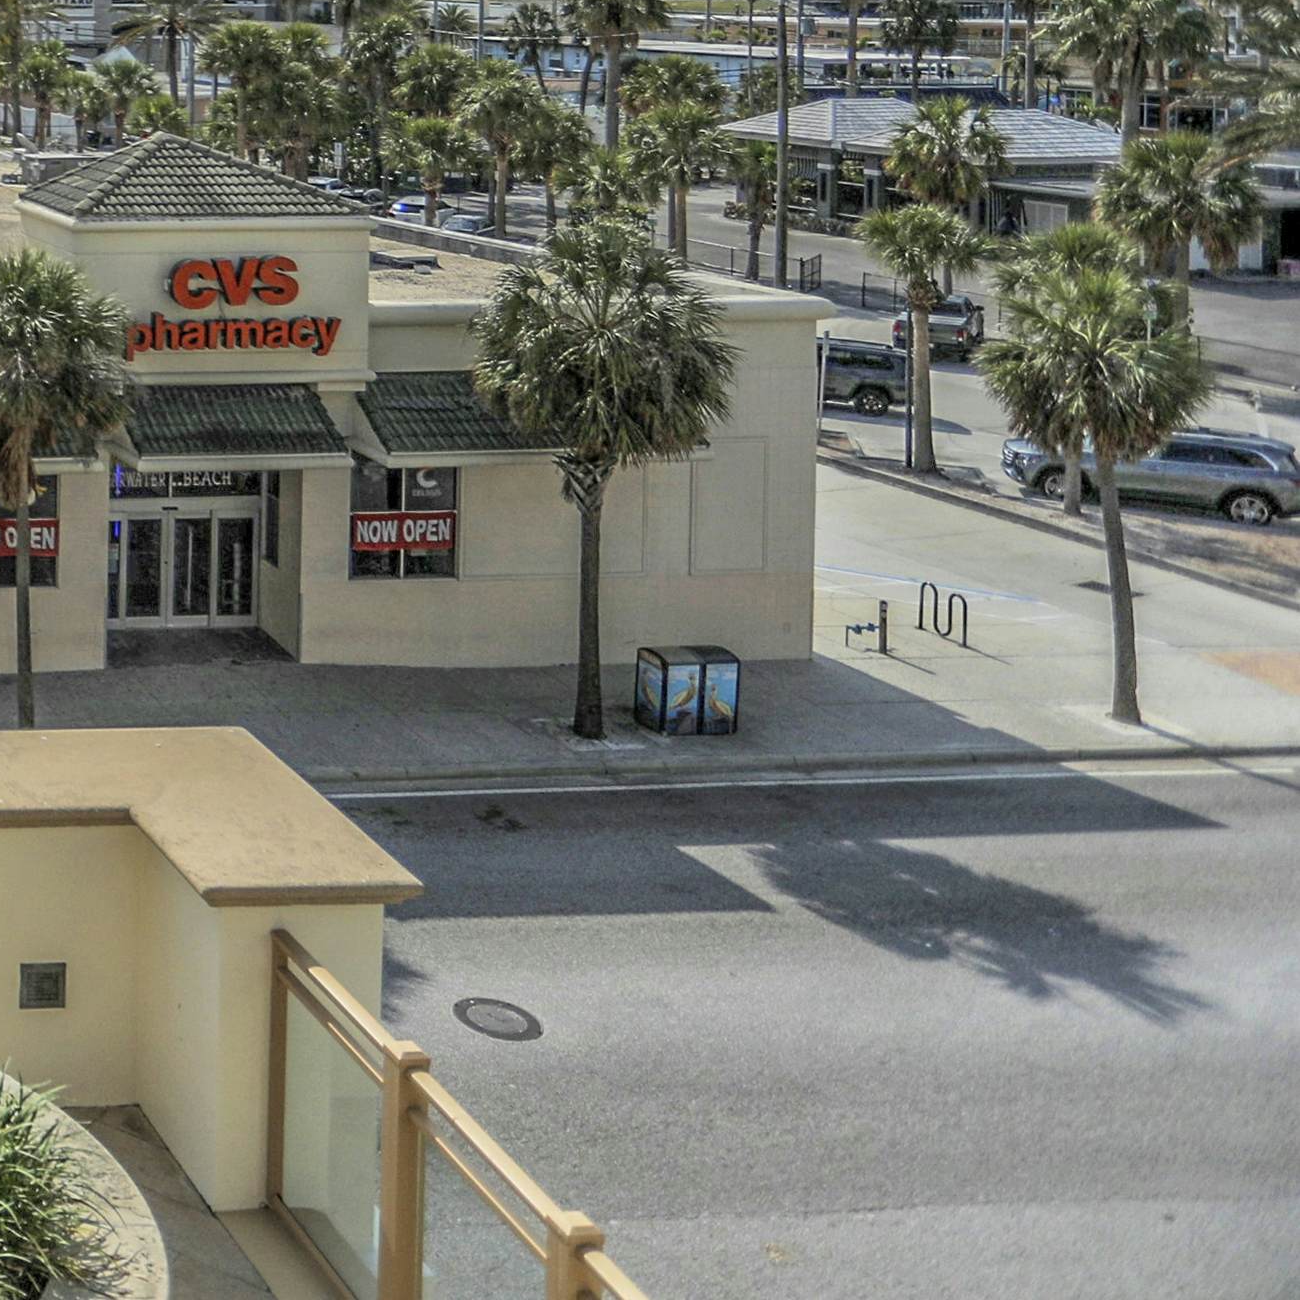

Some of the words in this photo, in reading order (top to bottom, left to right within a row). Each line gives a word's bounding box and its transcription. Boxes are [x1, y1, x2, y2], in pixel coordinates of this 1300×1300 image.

[166, 254, 300, 310] CVS
[126, 312, 342, 362] pharmacy
[112, 471, 166, 488] RWATER
[183, 471, 232, 486] BEACH
[4, 526, 56, 550] OEN
[357, 520, 398, 543] NOW
[403, 518, 451, 542] OPEN
